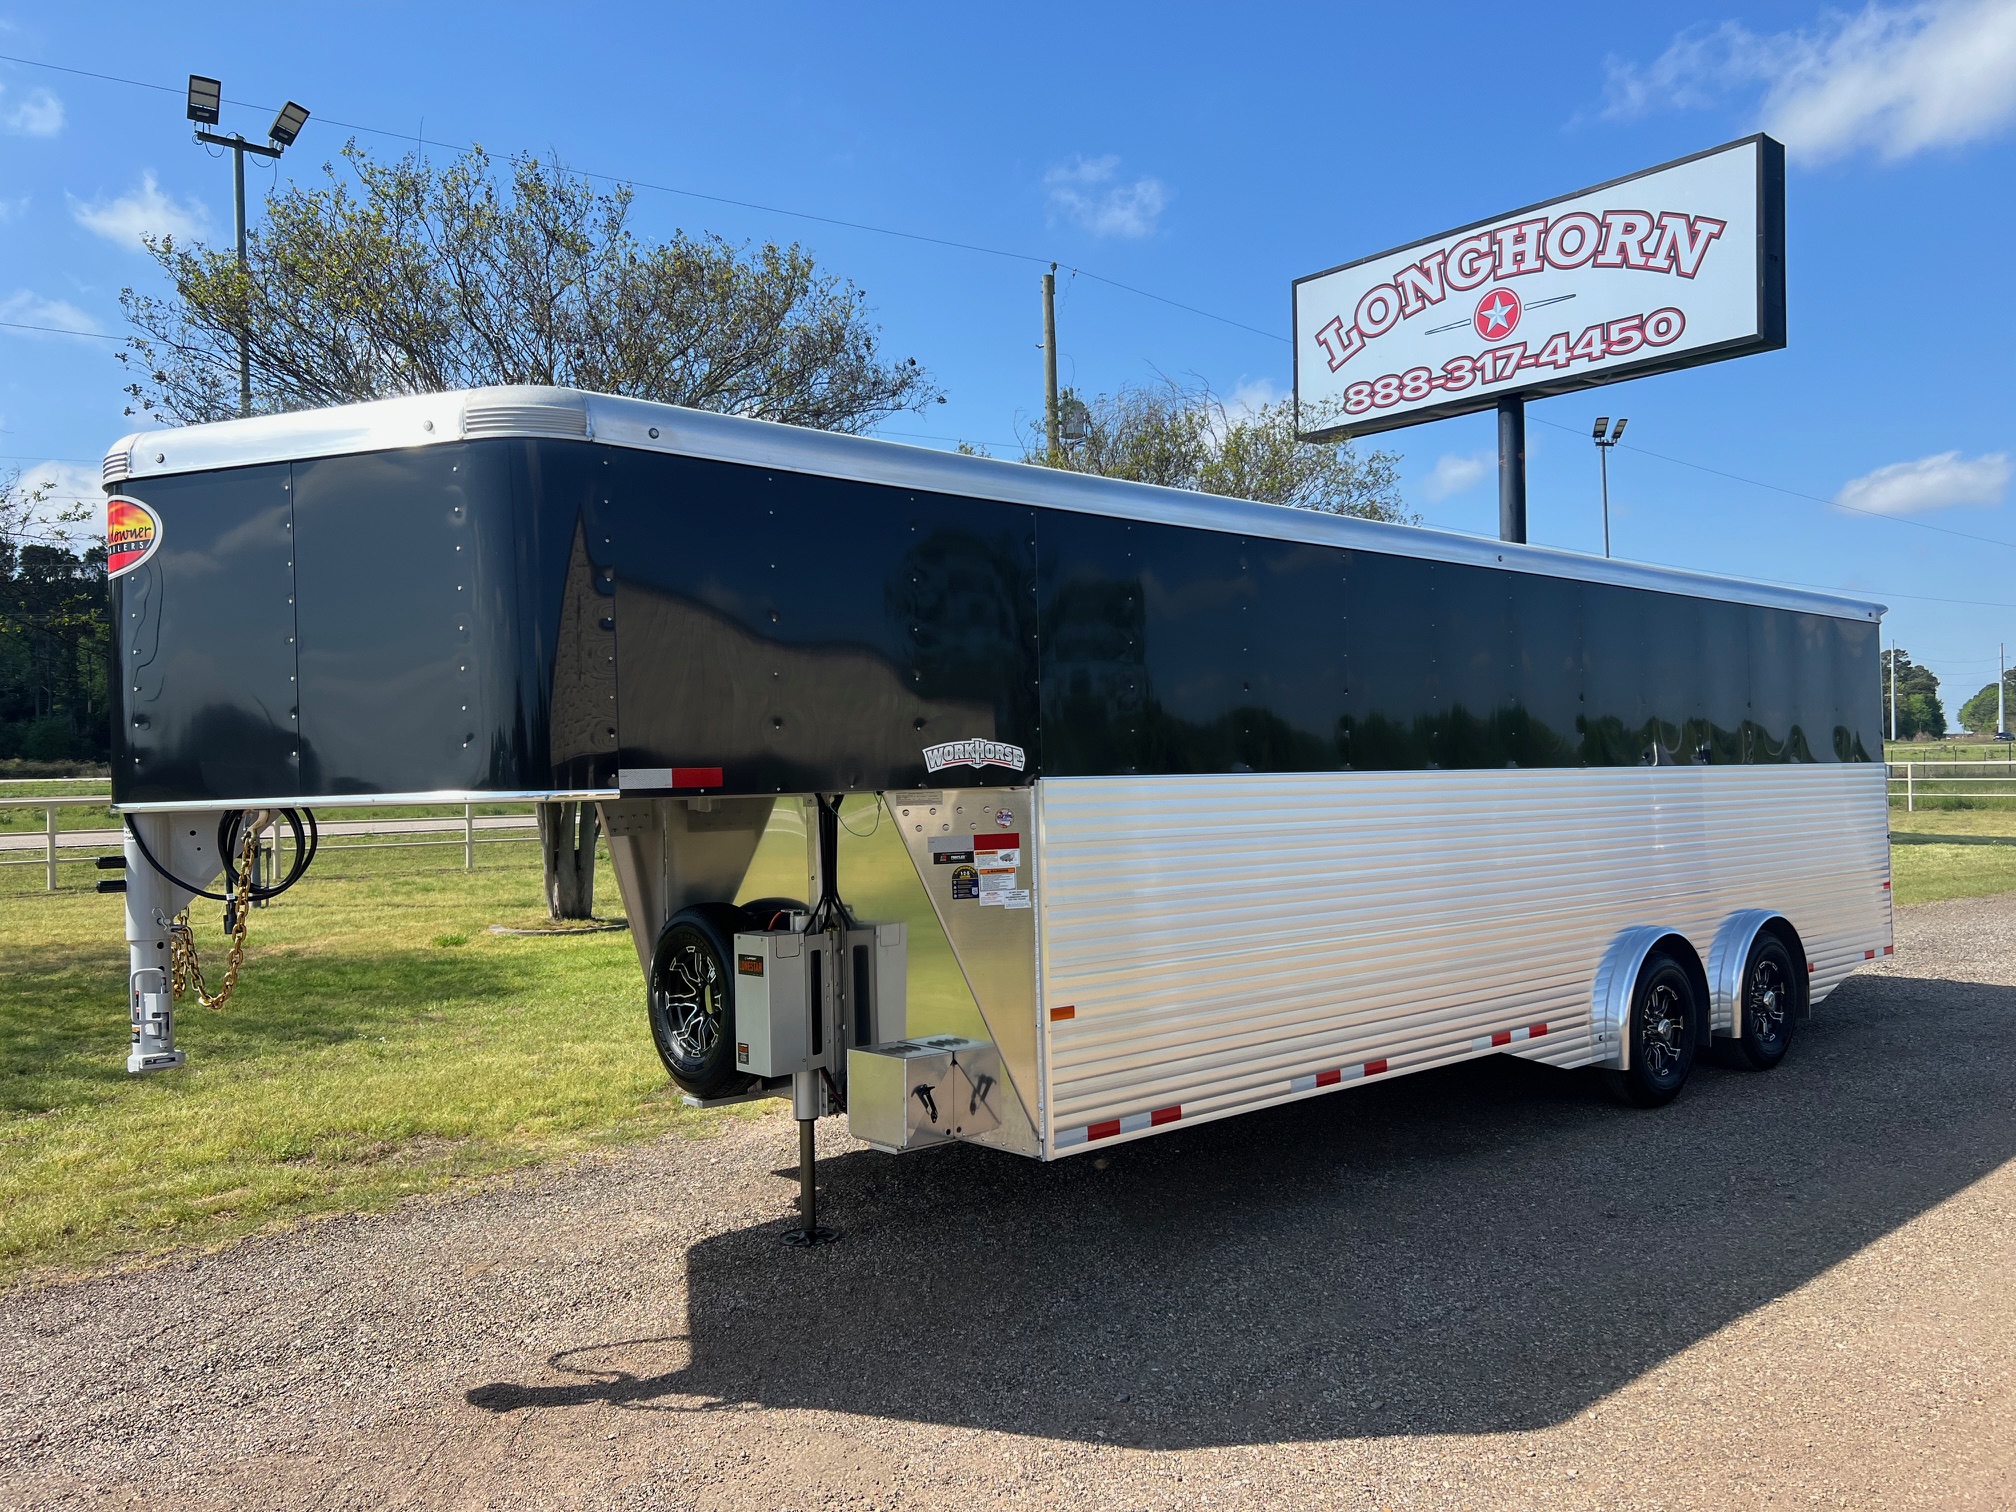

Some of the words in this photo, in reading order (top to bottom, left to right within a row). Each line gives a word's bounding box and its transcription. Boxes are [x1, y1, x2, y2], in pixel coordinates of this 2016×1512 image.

[1316, 209, 1727, 373] LONGHORN
[1343, 308, 1686, 414] 888-317-4450
[926, 740, 1023, 769] WORKHORSE
